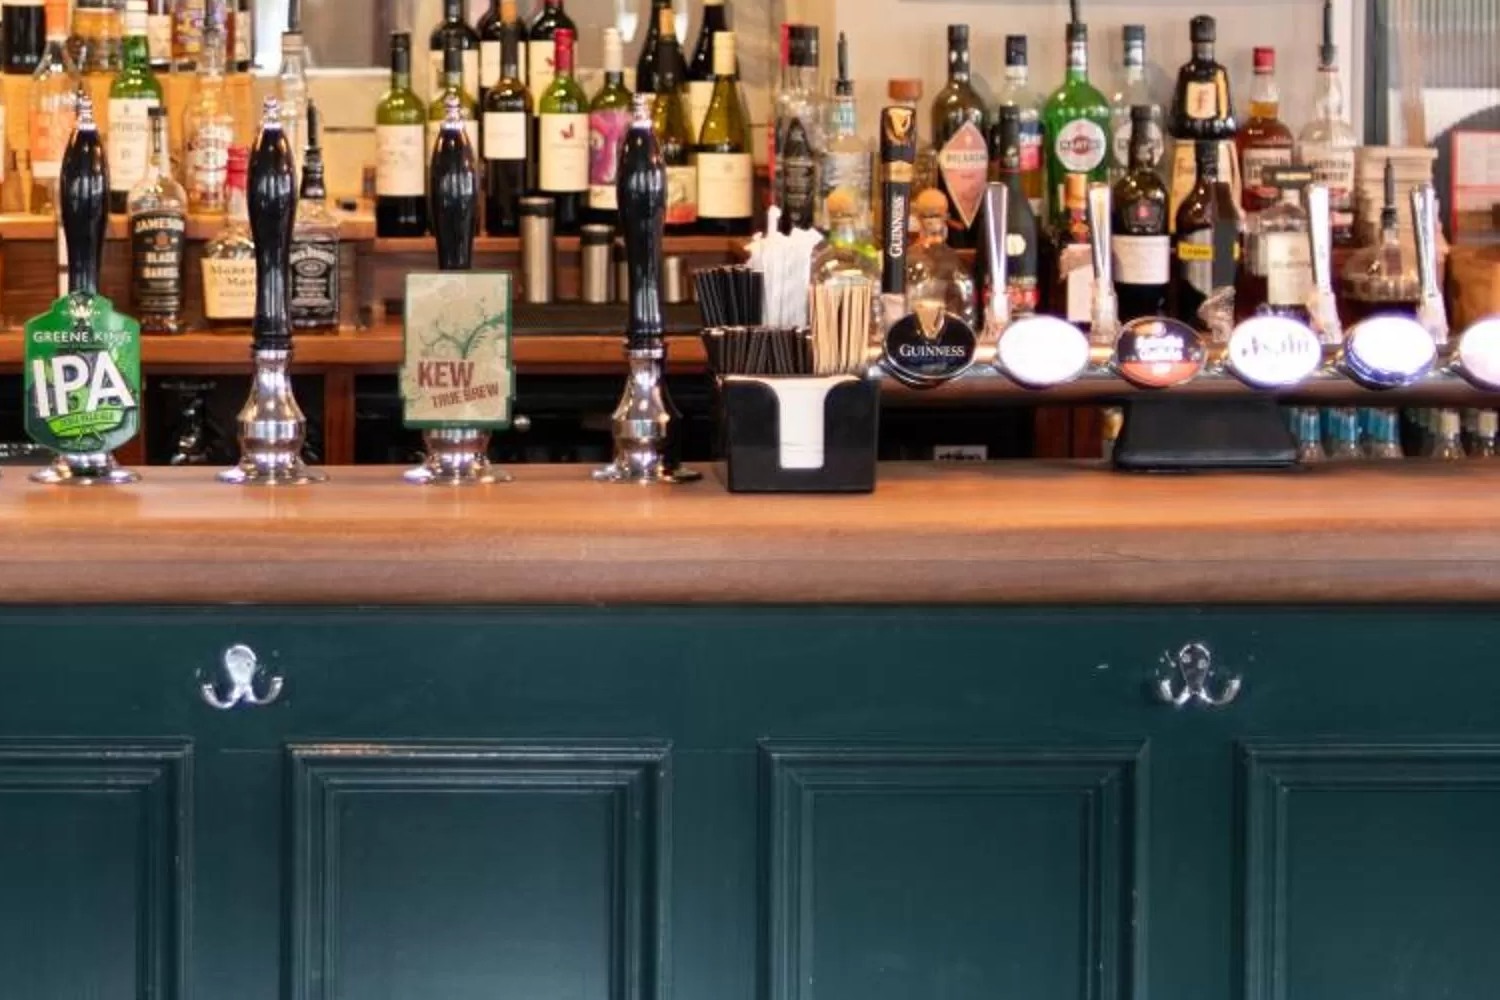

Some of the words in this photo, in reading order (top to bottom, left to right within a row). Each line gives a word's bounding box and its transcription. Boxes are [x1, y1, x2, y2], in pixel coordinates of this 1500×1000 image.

[889, 194, 905, 258] GUINNESS
[33, 330, 89, 343] GREENE
[93, 330, 133, 343] KING
[899, 342, 966, 358] GUINNESS
[32, 350, 136, 418] IPA
[417, 361, 476, 389] KEW
